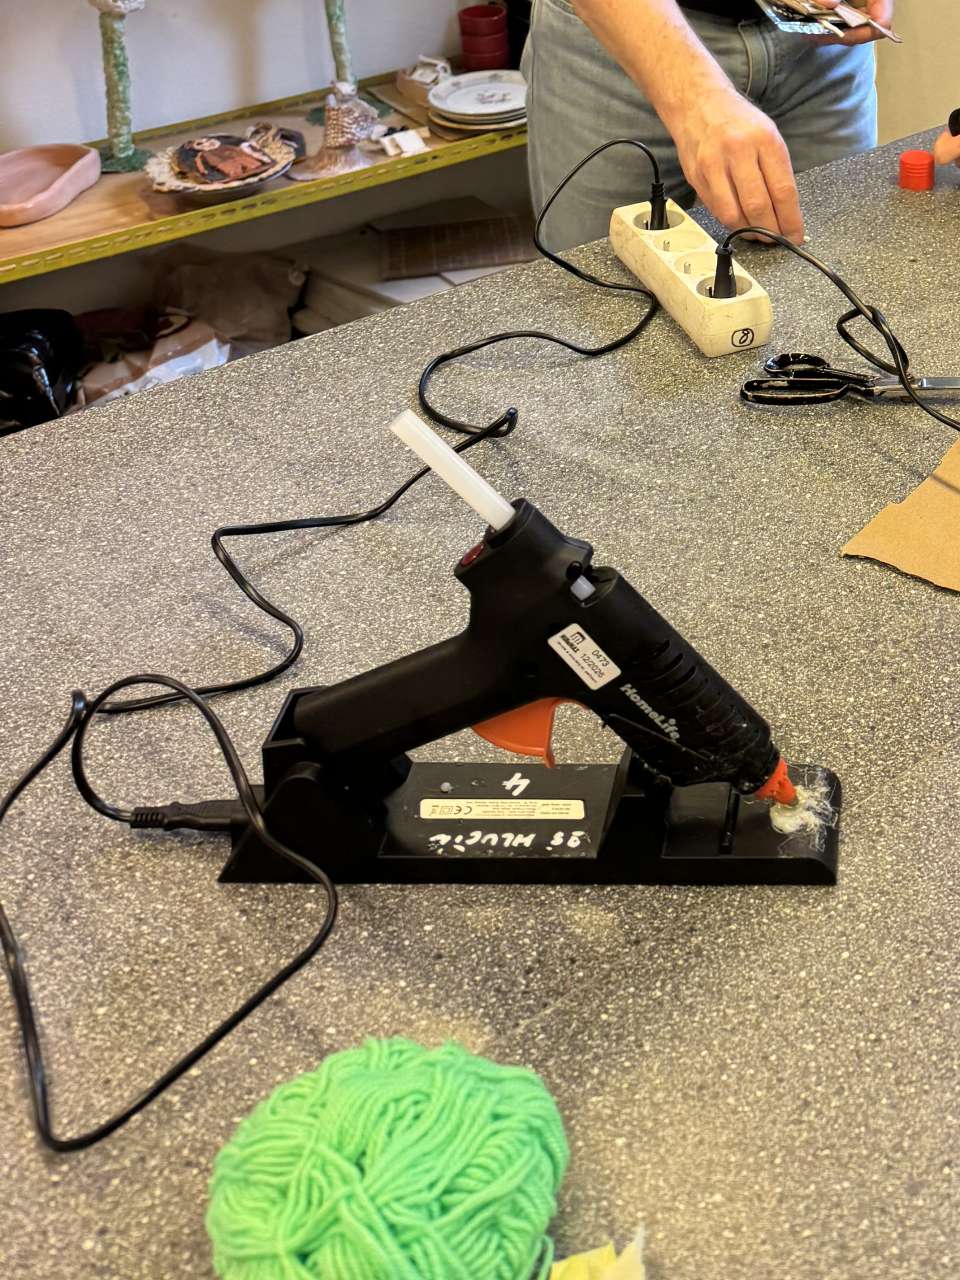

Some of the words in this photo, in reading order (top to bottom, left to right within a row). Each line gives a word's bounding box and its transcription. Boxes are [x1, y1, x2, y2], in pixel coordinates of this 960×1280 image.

[592, 650, 610, 667] 0473
[619, 683, 681, 743] HomeLife
[501, 772, 531, 797] 4
